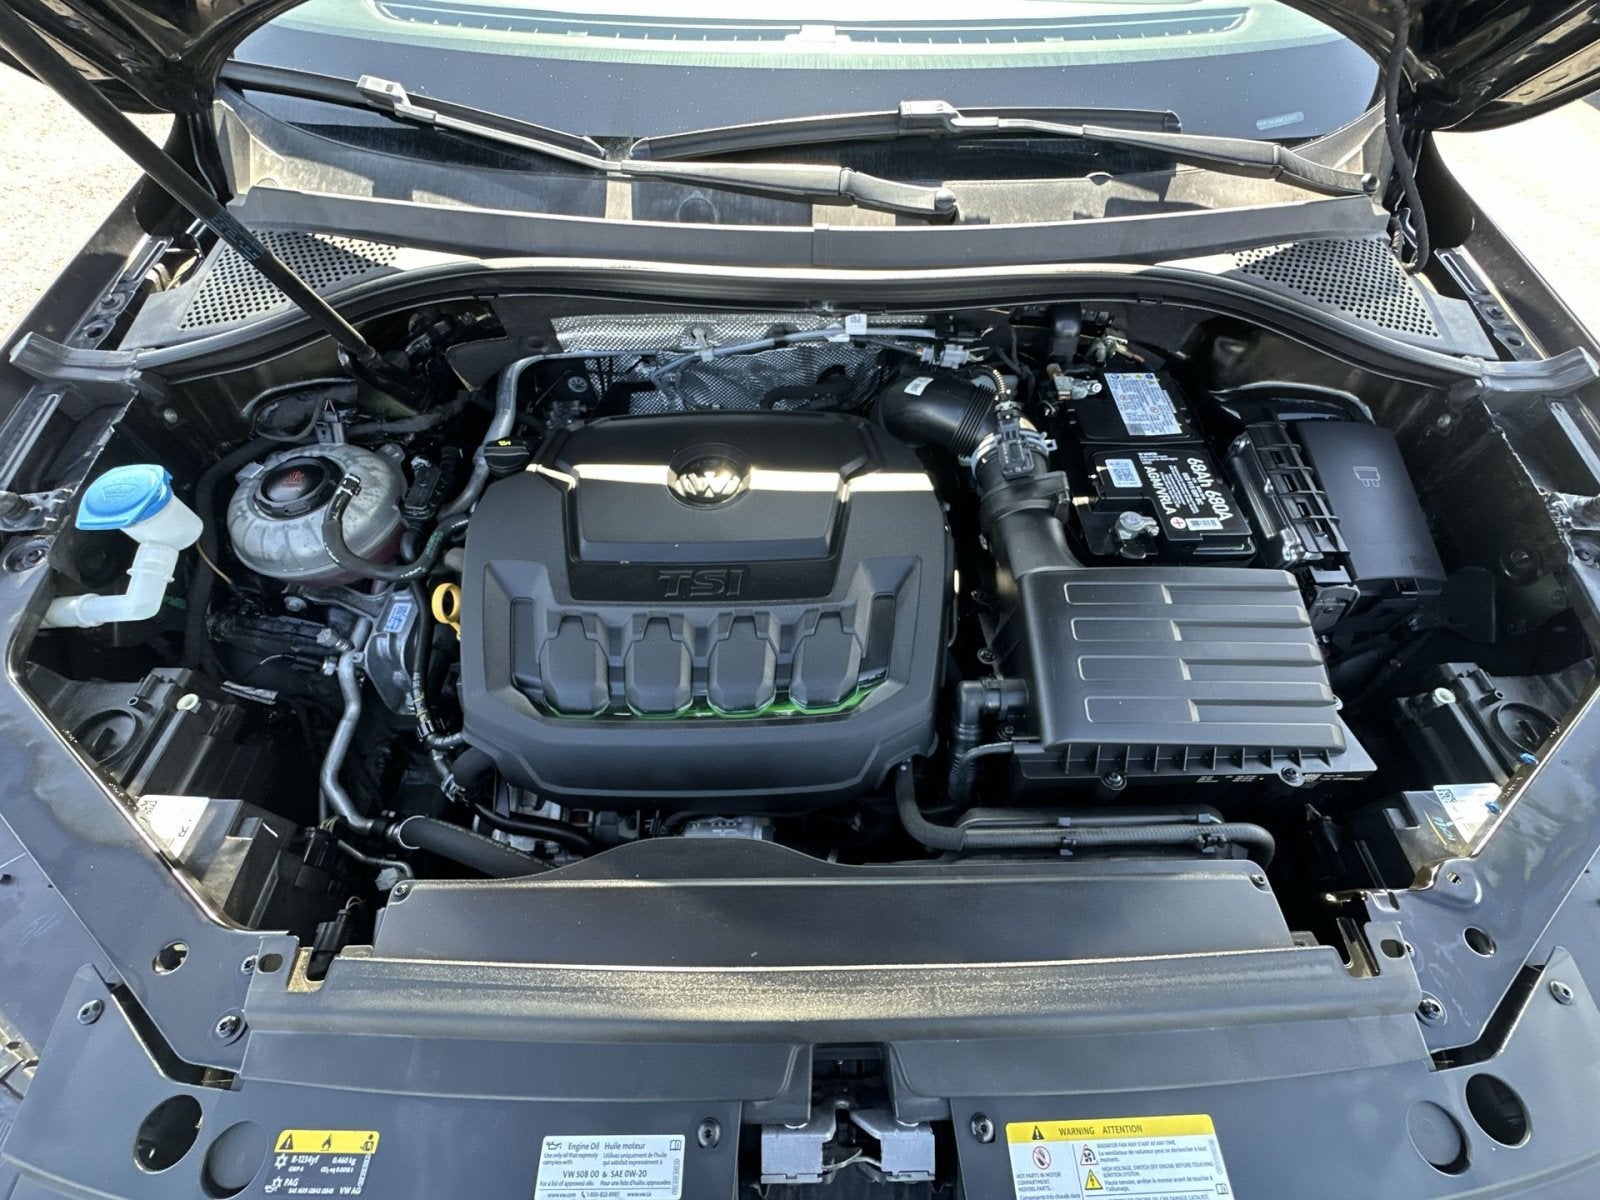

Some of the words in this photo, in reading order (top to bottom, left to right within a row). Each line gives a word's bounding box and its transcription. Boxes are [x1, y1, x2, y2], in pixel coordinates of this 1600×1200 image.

[1144, 466, 1177, 515] AGM/VRLA
[1186, 458, 1214, 487] 68Ah
[1205, 490, 1234, 521] 680A
[658, 569, 744, 597] TSI
[1059, 1126, 1094, 1136] WARNING
[1102, 1124, 1143, 1134] ATTENTION
[568, 1143, 589, 1152] Engine
[291, 1155, 320, 1166] R-1234yf
[349, 1157, 357, 1166] kg
[563, 1170, 575, 1178] VW
[576, 1170, 589, 1178] 508
[284, 1178, 299, 1187] PAG
